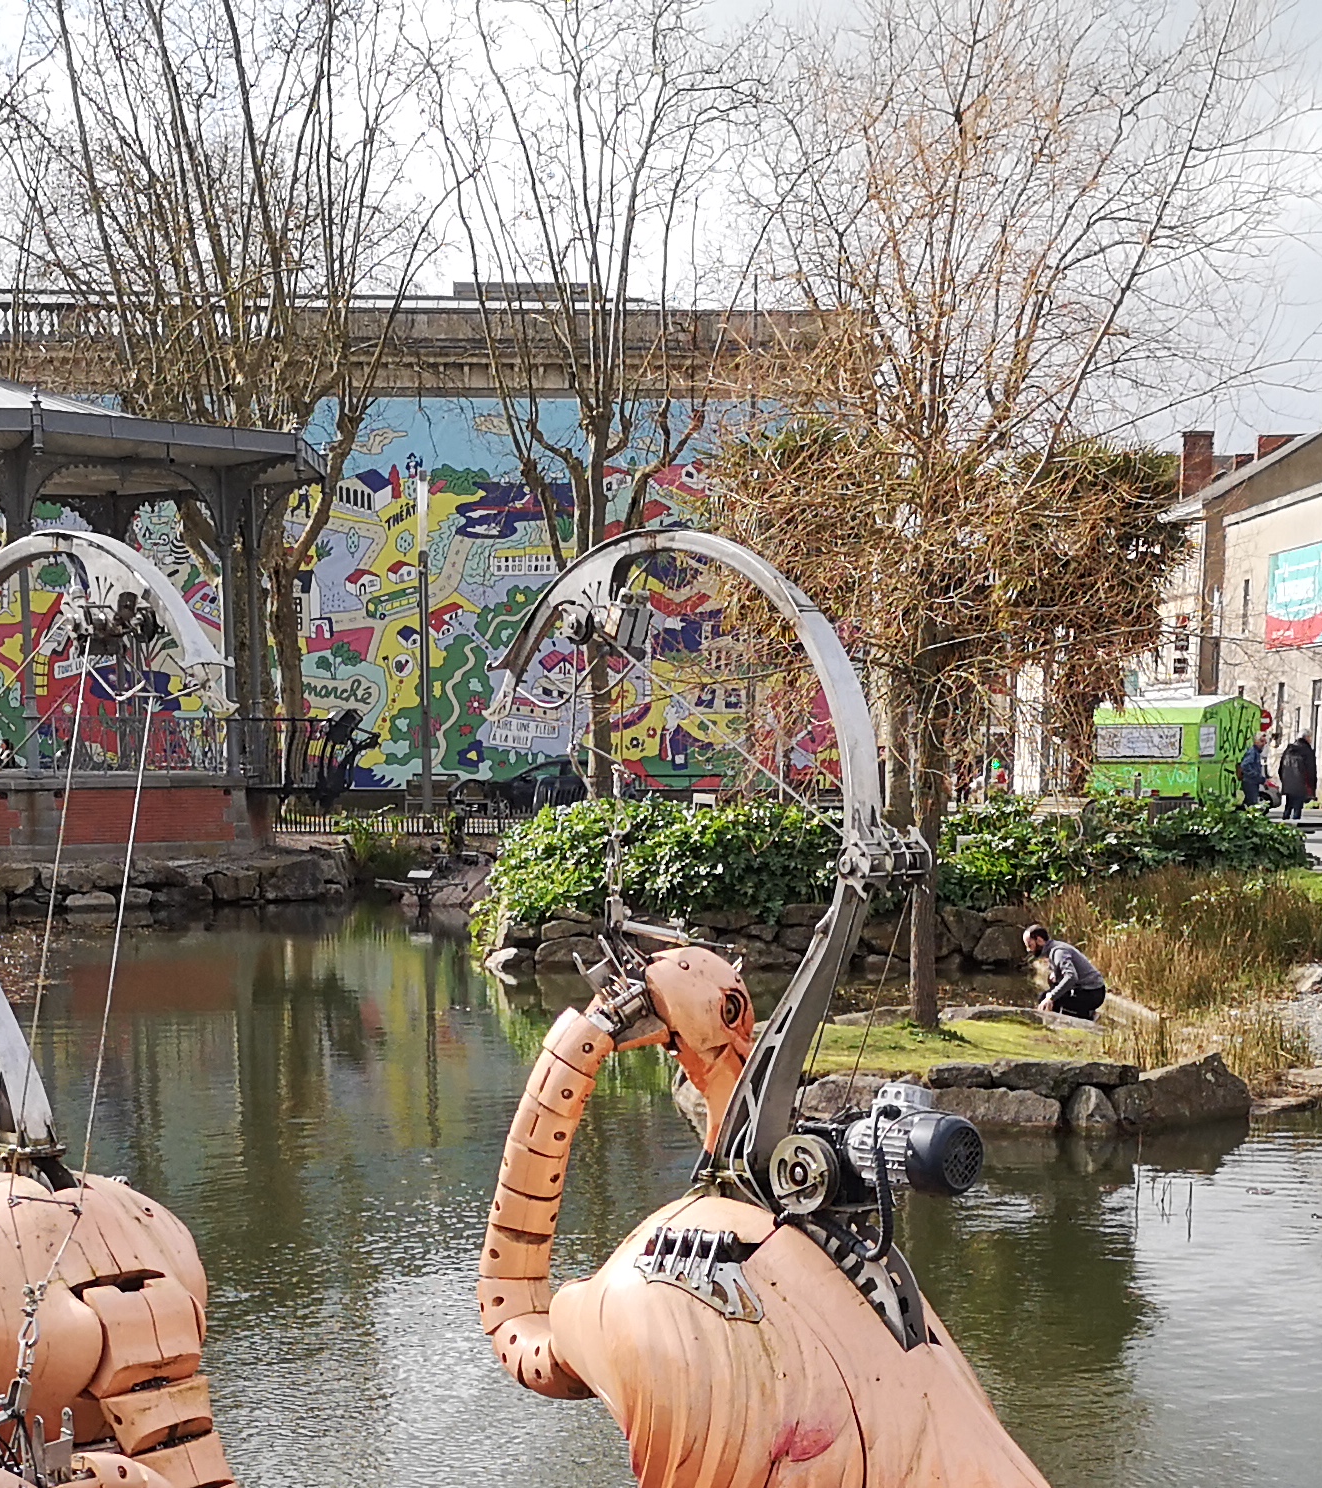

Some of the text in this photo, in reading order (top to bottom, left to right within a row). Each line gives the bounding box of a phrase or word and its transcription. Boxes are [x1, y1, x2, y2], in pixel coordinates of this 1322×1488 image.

[385, 502, 417, 531] THÉÂT
[302, 678, 373, 705] marché
[409, 714, 442, 748] YN
